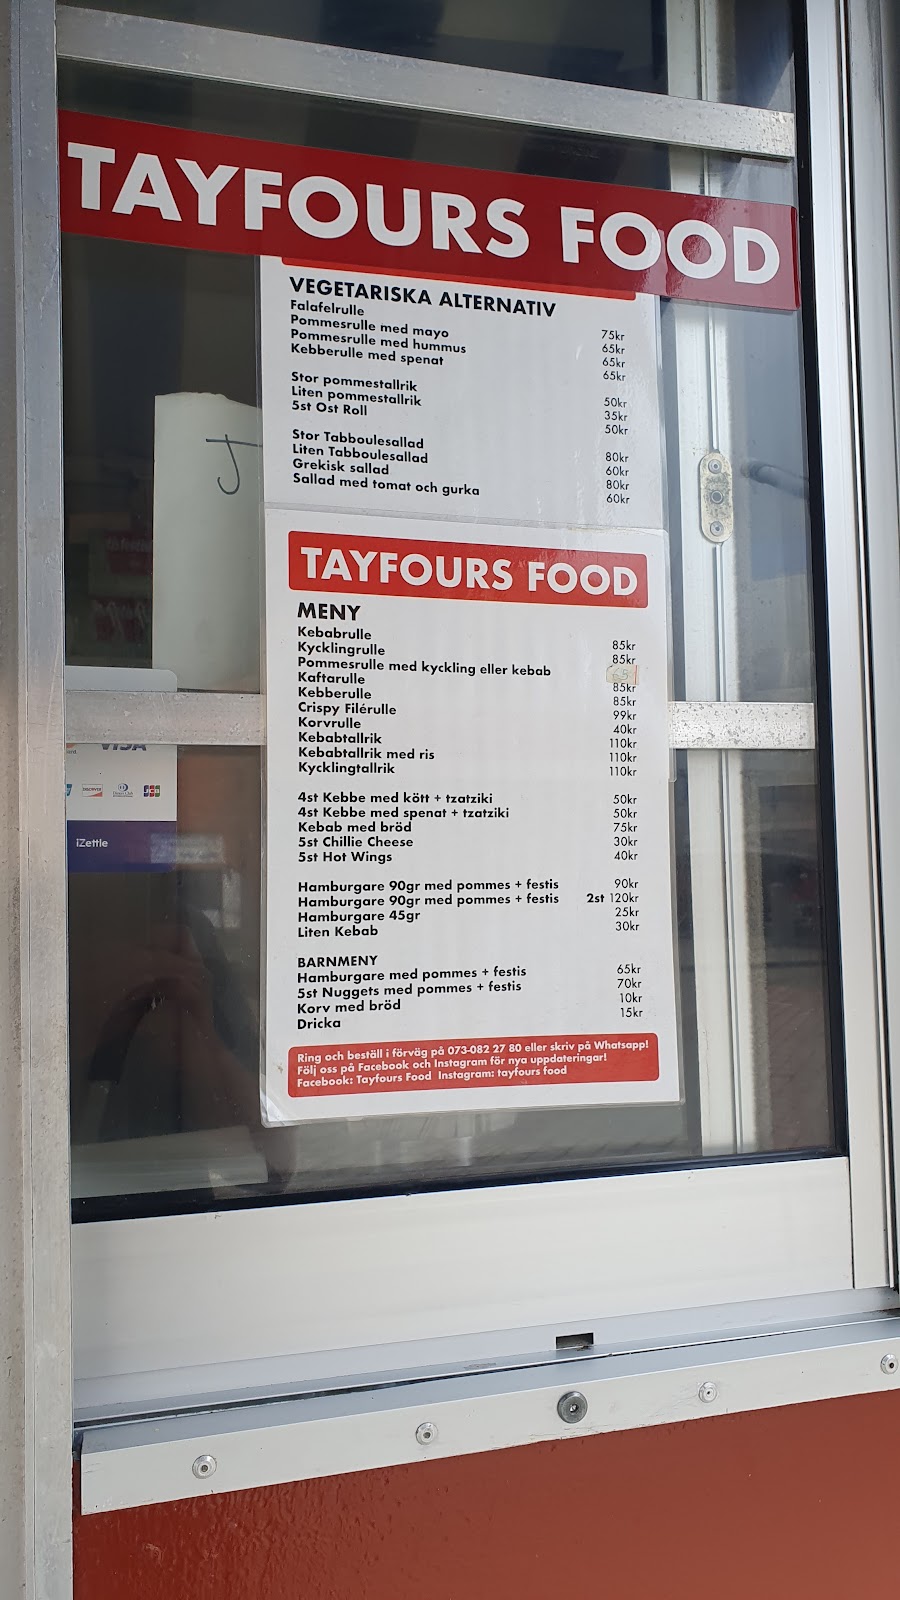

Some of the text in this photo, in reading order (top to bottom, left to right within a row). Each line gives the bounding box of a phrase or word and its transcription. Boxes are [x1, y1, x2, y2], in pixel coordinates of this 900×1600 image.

[66, 141, 781, 286] TAYFOURS FOOD
[289, 277, 556, 317] VEGETARISKA ALTERNATIV
[291, 300, 364, 316] Falafelrulle
[291, 314, 449, 340] Pommesrulle med mayo
[602, 330, 625, 340] 75kr
[291, 329, 466, 353] Pommesrulle med hummus
[292, 343, 443, 365] Kebberulle med spenat
[602, 344, 625, 354] 65kr
[603, 357, 625, 368] 65kr
[603, 371, 625, 381] 65kr
[292, 386, 421, 406] Liten pommestallrik
[292, 400, 367, 415] 5st Ost Roll
[604, 397, 627, 408] 50kr
[605, 411, 627, 421] 35kr
[605, 424, 628, 435] 50kr
[293, 429, 423, 449] Stor Tabboulesallad
[293, 444, 428, 463] Liten Tabboulesallad
[606, 452, 628, 462] 80kr
[293, 458, 389, 475] Grekisk sallad
[606, 466, 629, 476] 60kr
[294, 473, 479, 496] Sallad med tomat och gurka
[606, 480, 629, 490] 80kr
[607, 494, 630, 503] 60kr
[301, 547, 637, 595] TAYFOURS FOOD
[298, 602, 361, 621] MENY
[298, 626, 371, 640] Kebabrulle
[298, 642, 385, 657] Kycklingrulle
[613, 640, 635, 650] 85kr
[613, 654, 635, 664] 85kr
[298, 657, 551, 676] Pommesrulle med kyckling eller kebab
[298, 672, 365, 684] Kaftarulle
[613, 682, 636, 692] 85kr
[299, 687, 371, 699] Kebberulle
[613, 696, 636, 706] 85kr
[298, 702, 396, 716] Crispy Filérulle
[613, 710, 636, 720] 99kr
[299, 717, 361, 728] Korvrulle
[613, 724, 637, 734] 40kr
[299, 731, 381, 743] Kebabtallrik
[610, 738, 637, 748] 110kr
[299, 746, 434, 759] Kebabtallrik med ris
[610, 752, 637, 762] 110kr
[299, 761, 395, 776] Kycklingtallrik
[610, 766, 637, 776] 110kr
[613, 794, 637, 804] 50kr
[298, 806, 509, 820] 4st Kebbe med spenat tzatziki
[613, 808, 637, 818] 50kr
[299, 821, 411, 832] Kebab med bröd
[614, 822, 637, 832] 75kr
[76, 838, 108, 848] iZettle
[299, 836, 413, 847] 5st Chillie Cheese
[614, 836, 638, 846] 30kr
[299, 851, 392, 864] 5st Hot Wings
[614, 850, 638, 860] 40kr
[299, 879, 558, 894] Hamburgare 90gr med pommes festis
[615, 878, 638, 888] 90kr
[587, 892, 639, 903] 2st 120kr
[299, 910, 420, 924] Hamburgare 45gr
[615, 906, 639, 917] 25kr
[298, 925, 378, 937] Liten Kebab
[616, 920, 639, 931] 30kr
[298, 956, 377, 968] BARNMENY
[617, 963, 641, 974] 65kr
[617, 978, 641, 988] 70kr
[298, 980, 521, 1000] 5st Nuggets med pommes festis
[620, 992, 642, 1003] 10kr
[298, 999, 400, 1014] Korv med bröd
[621, 1007, 643, 1017] 15kr
[298, 1017, 340, 1029] Dricka
[298, 1053, 321, 1064] Ring
[325, 1051, 344, 1061] och
[348, 1049, 382, 1060] beställ
[392, 1048, 427, 1058] förväg
[431, 1046, 444, 1058] på
[448, 1045, 489, 1055] 073-082
[493, 1044, 506, 1053] 27
[509, 1044, 522, 1052] 80
[525, 1042, 547, 1052] eller
[550, 1042, 575, 1051] skriv
[578, 1041, 591, 1052] på
[594, 1040, 648, 1051] Whatsapp!
[298, 1065, 316, 1077] Följ
[341, 1063, 354, 1075] på
[358, 1060, 409, 1071] Facebook
[413, 1059, 431, 1068] och
[434, 1059, 487, 1069] Instagram
[490, 1056, 505, 1065] för
[508, 1058, 527, 1066] nya
[531, 1053, 607, 1066] uppdateringar!
[298, 1065, 567, 1087] Facebook: Tayfours Food Instagram: tayfours food
